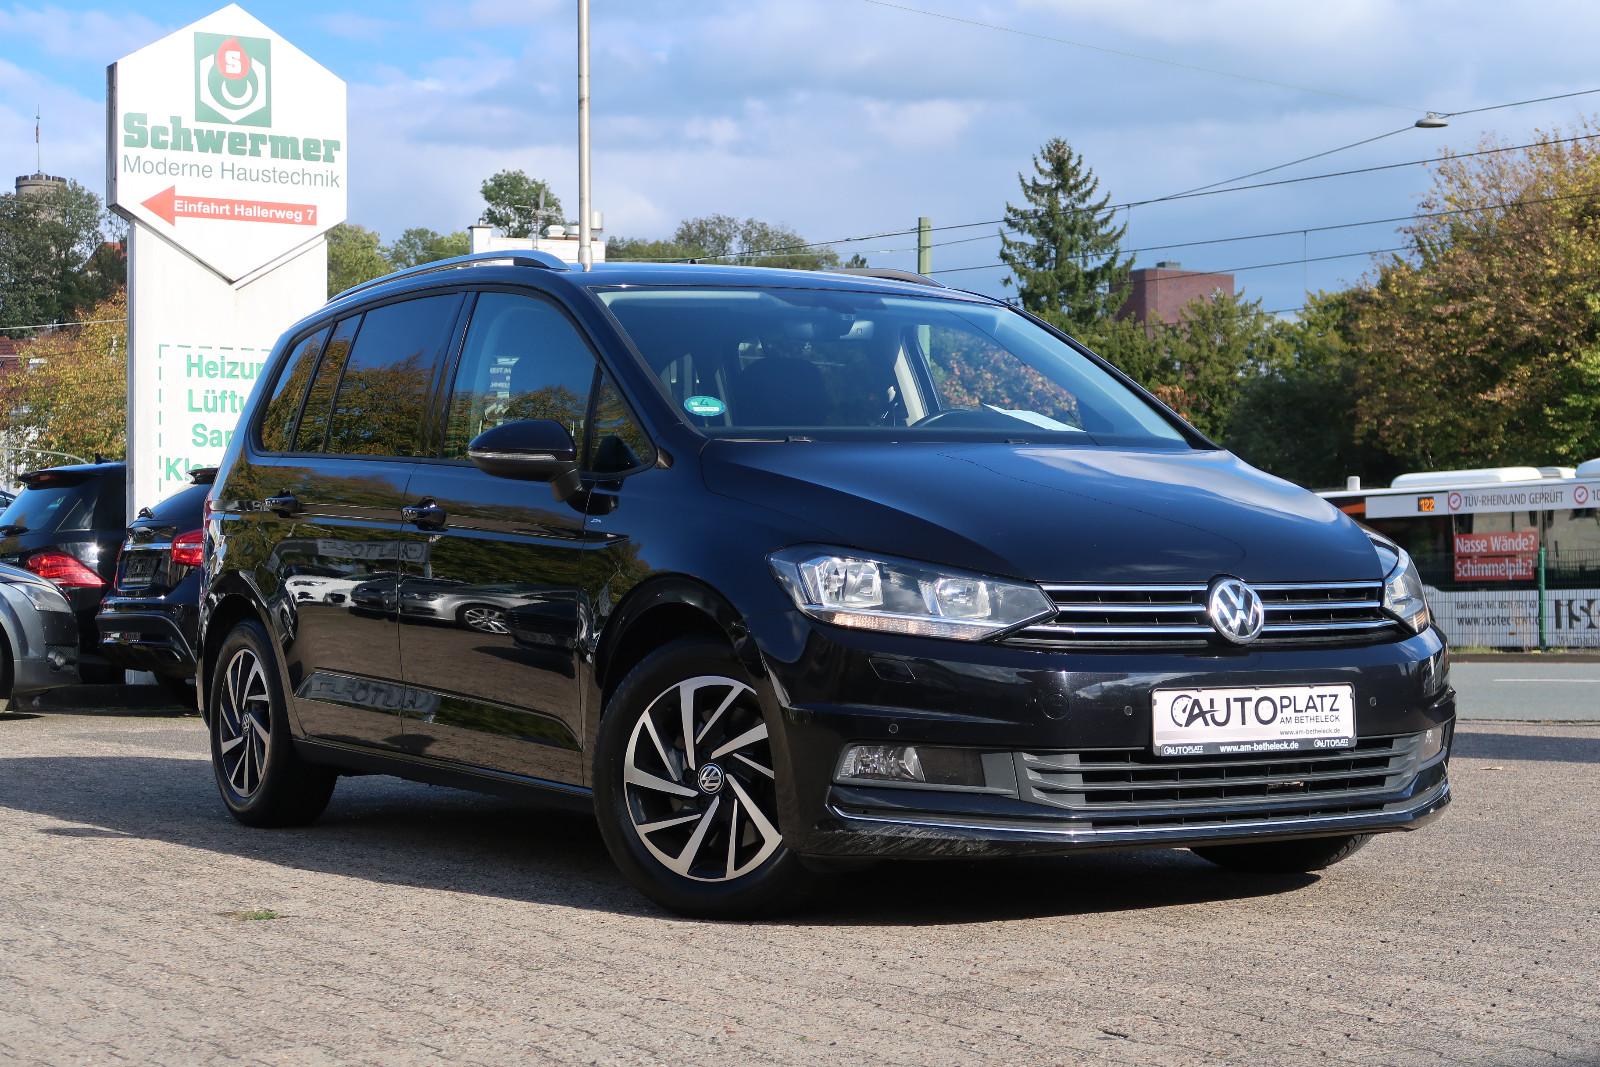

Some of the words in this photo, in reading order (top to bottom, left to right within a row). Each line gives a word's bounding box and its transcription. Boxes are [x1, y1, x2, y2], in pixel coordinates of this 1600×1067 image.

[224, 50, 242, 74] S
[123, 112, 341, 163] Schwermer
[123, 154, 213, 179] Moderne
[221, 161, 340, 188] Haustechnik
[174, 200, 230, 216] Einfahrt
[234, 204, 303, 222] Hallerweg
[306, 209, 315, 221] 7
[165, 457, 218, 481] Kl
[1419, 498, 1435, 512] 122
[1464, 492, 1526, 508] TÜV-RHEINLAND
[1529, 490, 1563, 505] GEPRÜFT
[1455, 538, 1488, 553] Nasse
[1490, 535, 1535, 552] Wände?
[1455, 560, 1533, 580] Schimmelpilz?
[1280, 716, 1293, 725] AM
[1295, 714, 1340, 724] BETHELECK
[1280, 728, 1341, 736] www.am-betheleck.de
[1219, 741, 1299, 754] www.am-betheleck.de
